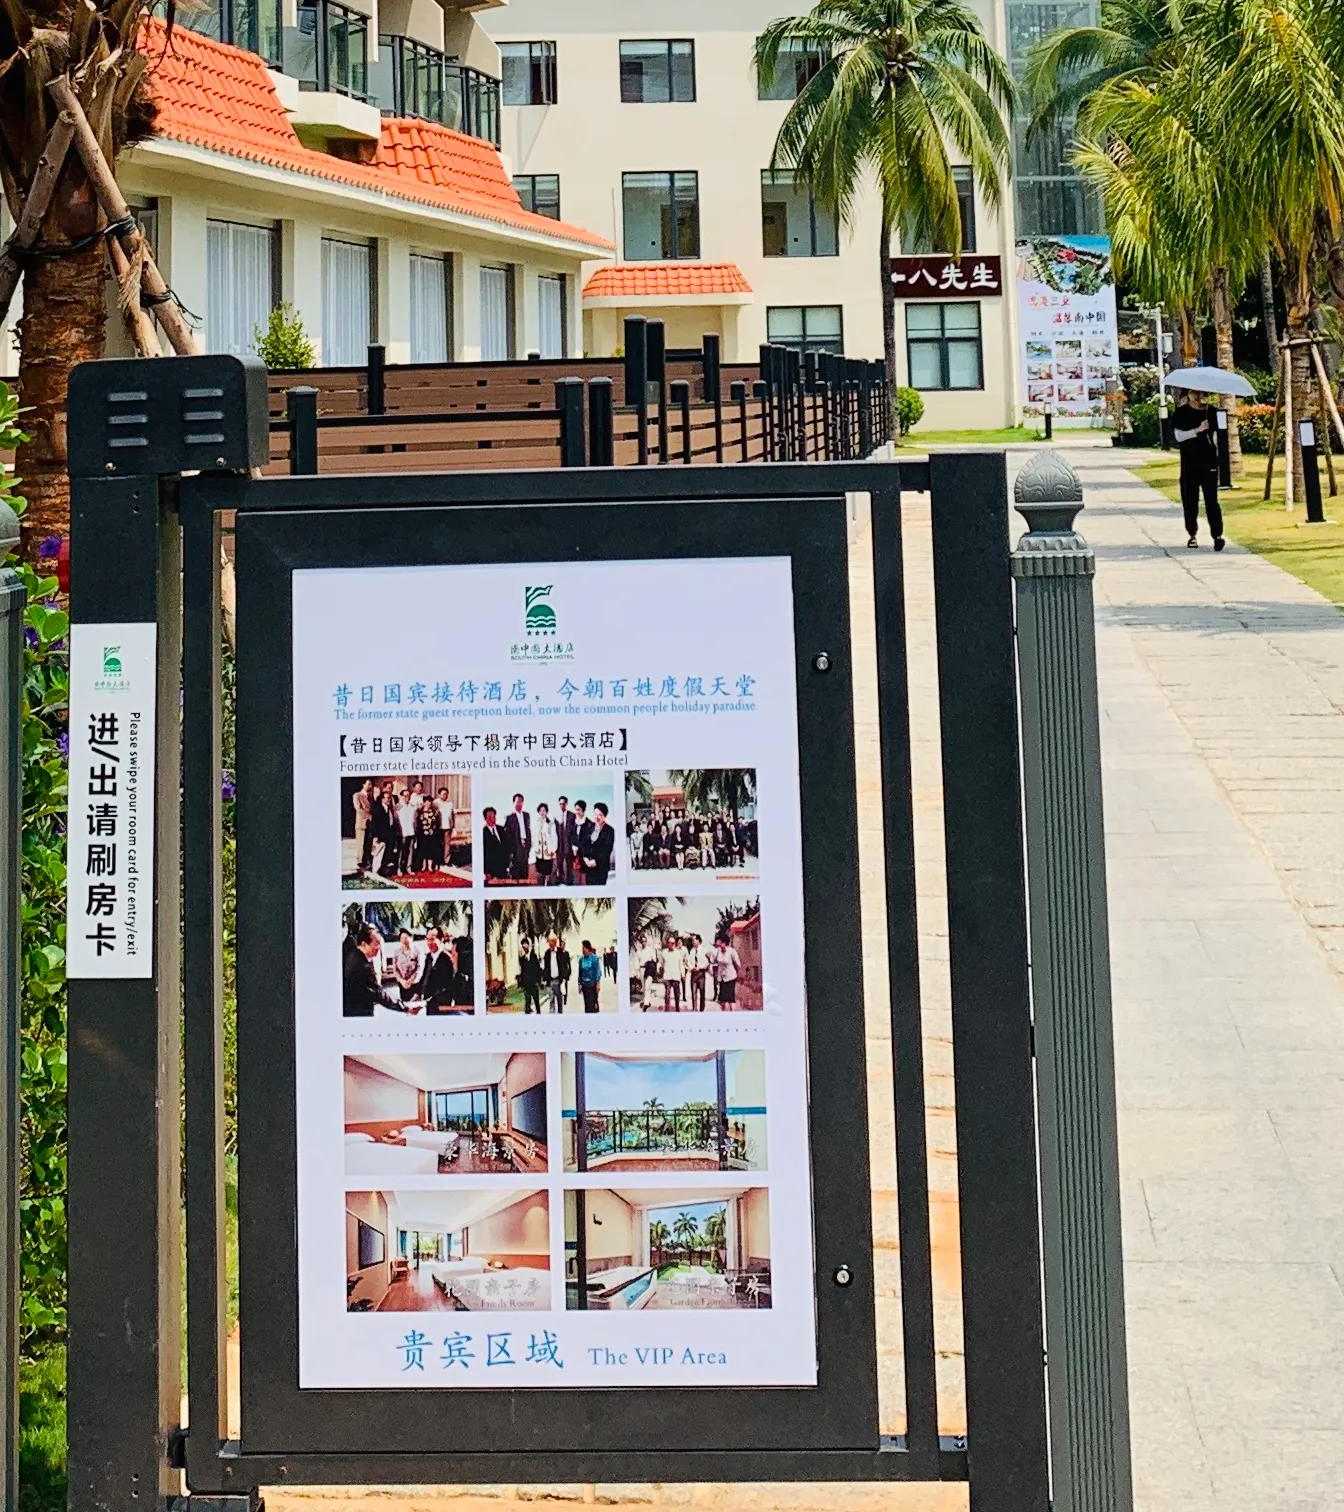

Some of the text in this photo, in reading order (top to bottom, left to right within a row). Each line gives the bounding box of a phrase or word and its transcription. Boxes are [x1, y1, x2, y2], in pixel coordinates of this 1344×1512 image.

[335, 709, 354, 720] The
[357, 708, 392, 719] former
[395, 709, 418, 719] state
[422, 709, 449, 721] guest
[452, 707, 502, 720] reception
[539, 706, 561, 715] now
[564, 704, 581, 714] the
[584, 704, 630, 714] common
[633, 703, 669, 716] people
[671, 701, 711, 715] holiday
[340, 754, 628, 772] Former state leaders stayed in the South China Hotel
[86, 713, 119, 956] 进/出请刷房卡
[124, 712, 141, 955] Please swipe your room card for entry/exit
[395, 1329, 564, 1371] 贵宾区域
[587, 1347, 728, 1365] The VIP Area
